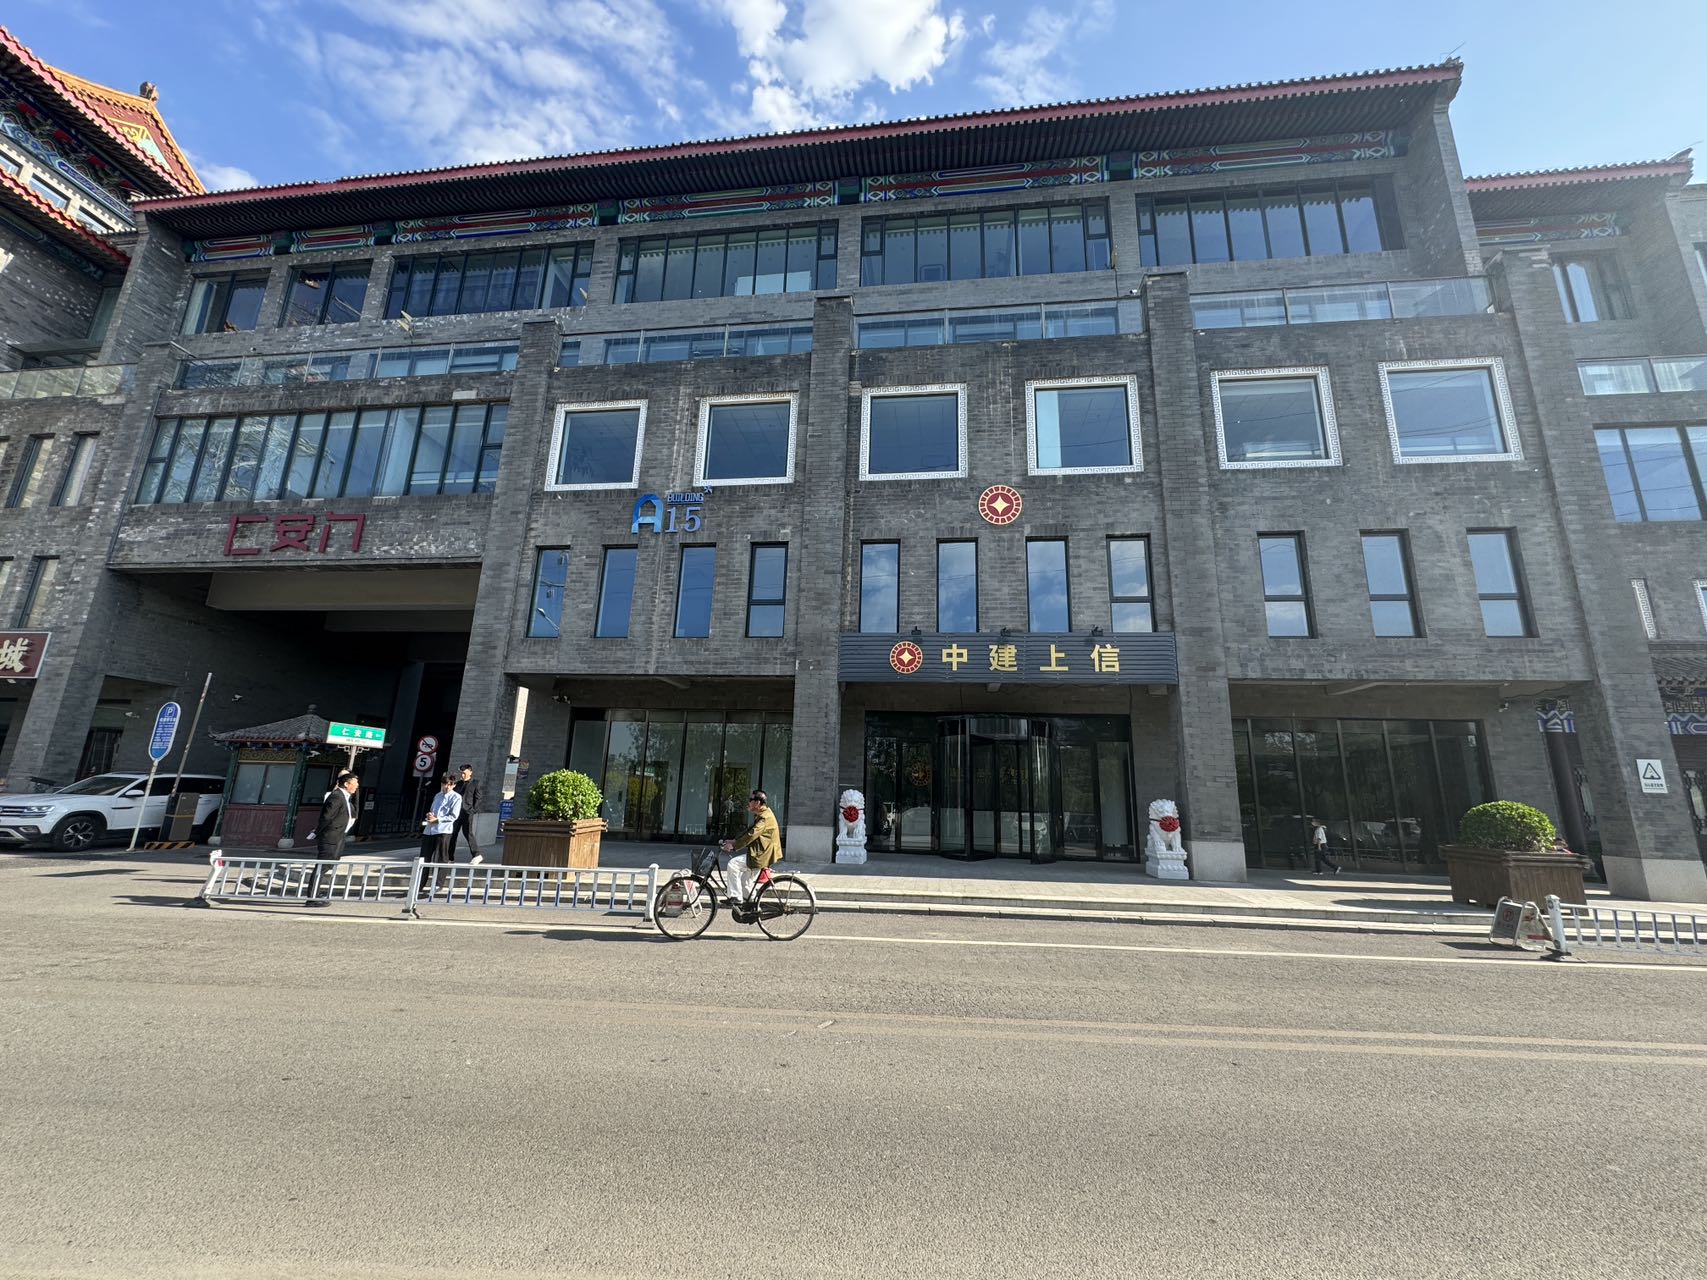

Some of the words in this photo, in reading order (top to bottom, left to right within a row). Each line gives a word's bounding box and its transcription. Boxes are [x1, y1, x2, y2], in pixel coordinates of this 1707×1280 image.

[668, 492, 704, 502] BUILDING
[223, 511, 366, 556] 仁安门
[0, 637, 29, 673] 城
[941, 643, 1120, 673] 中建上信
[419, 757, 427, 768] 5
